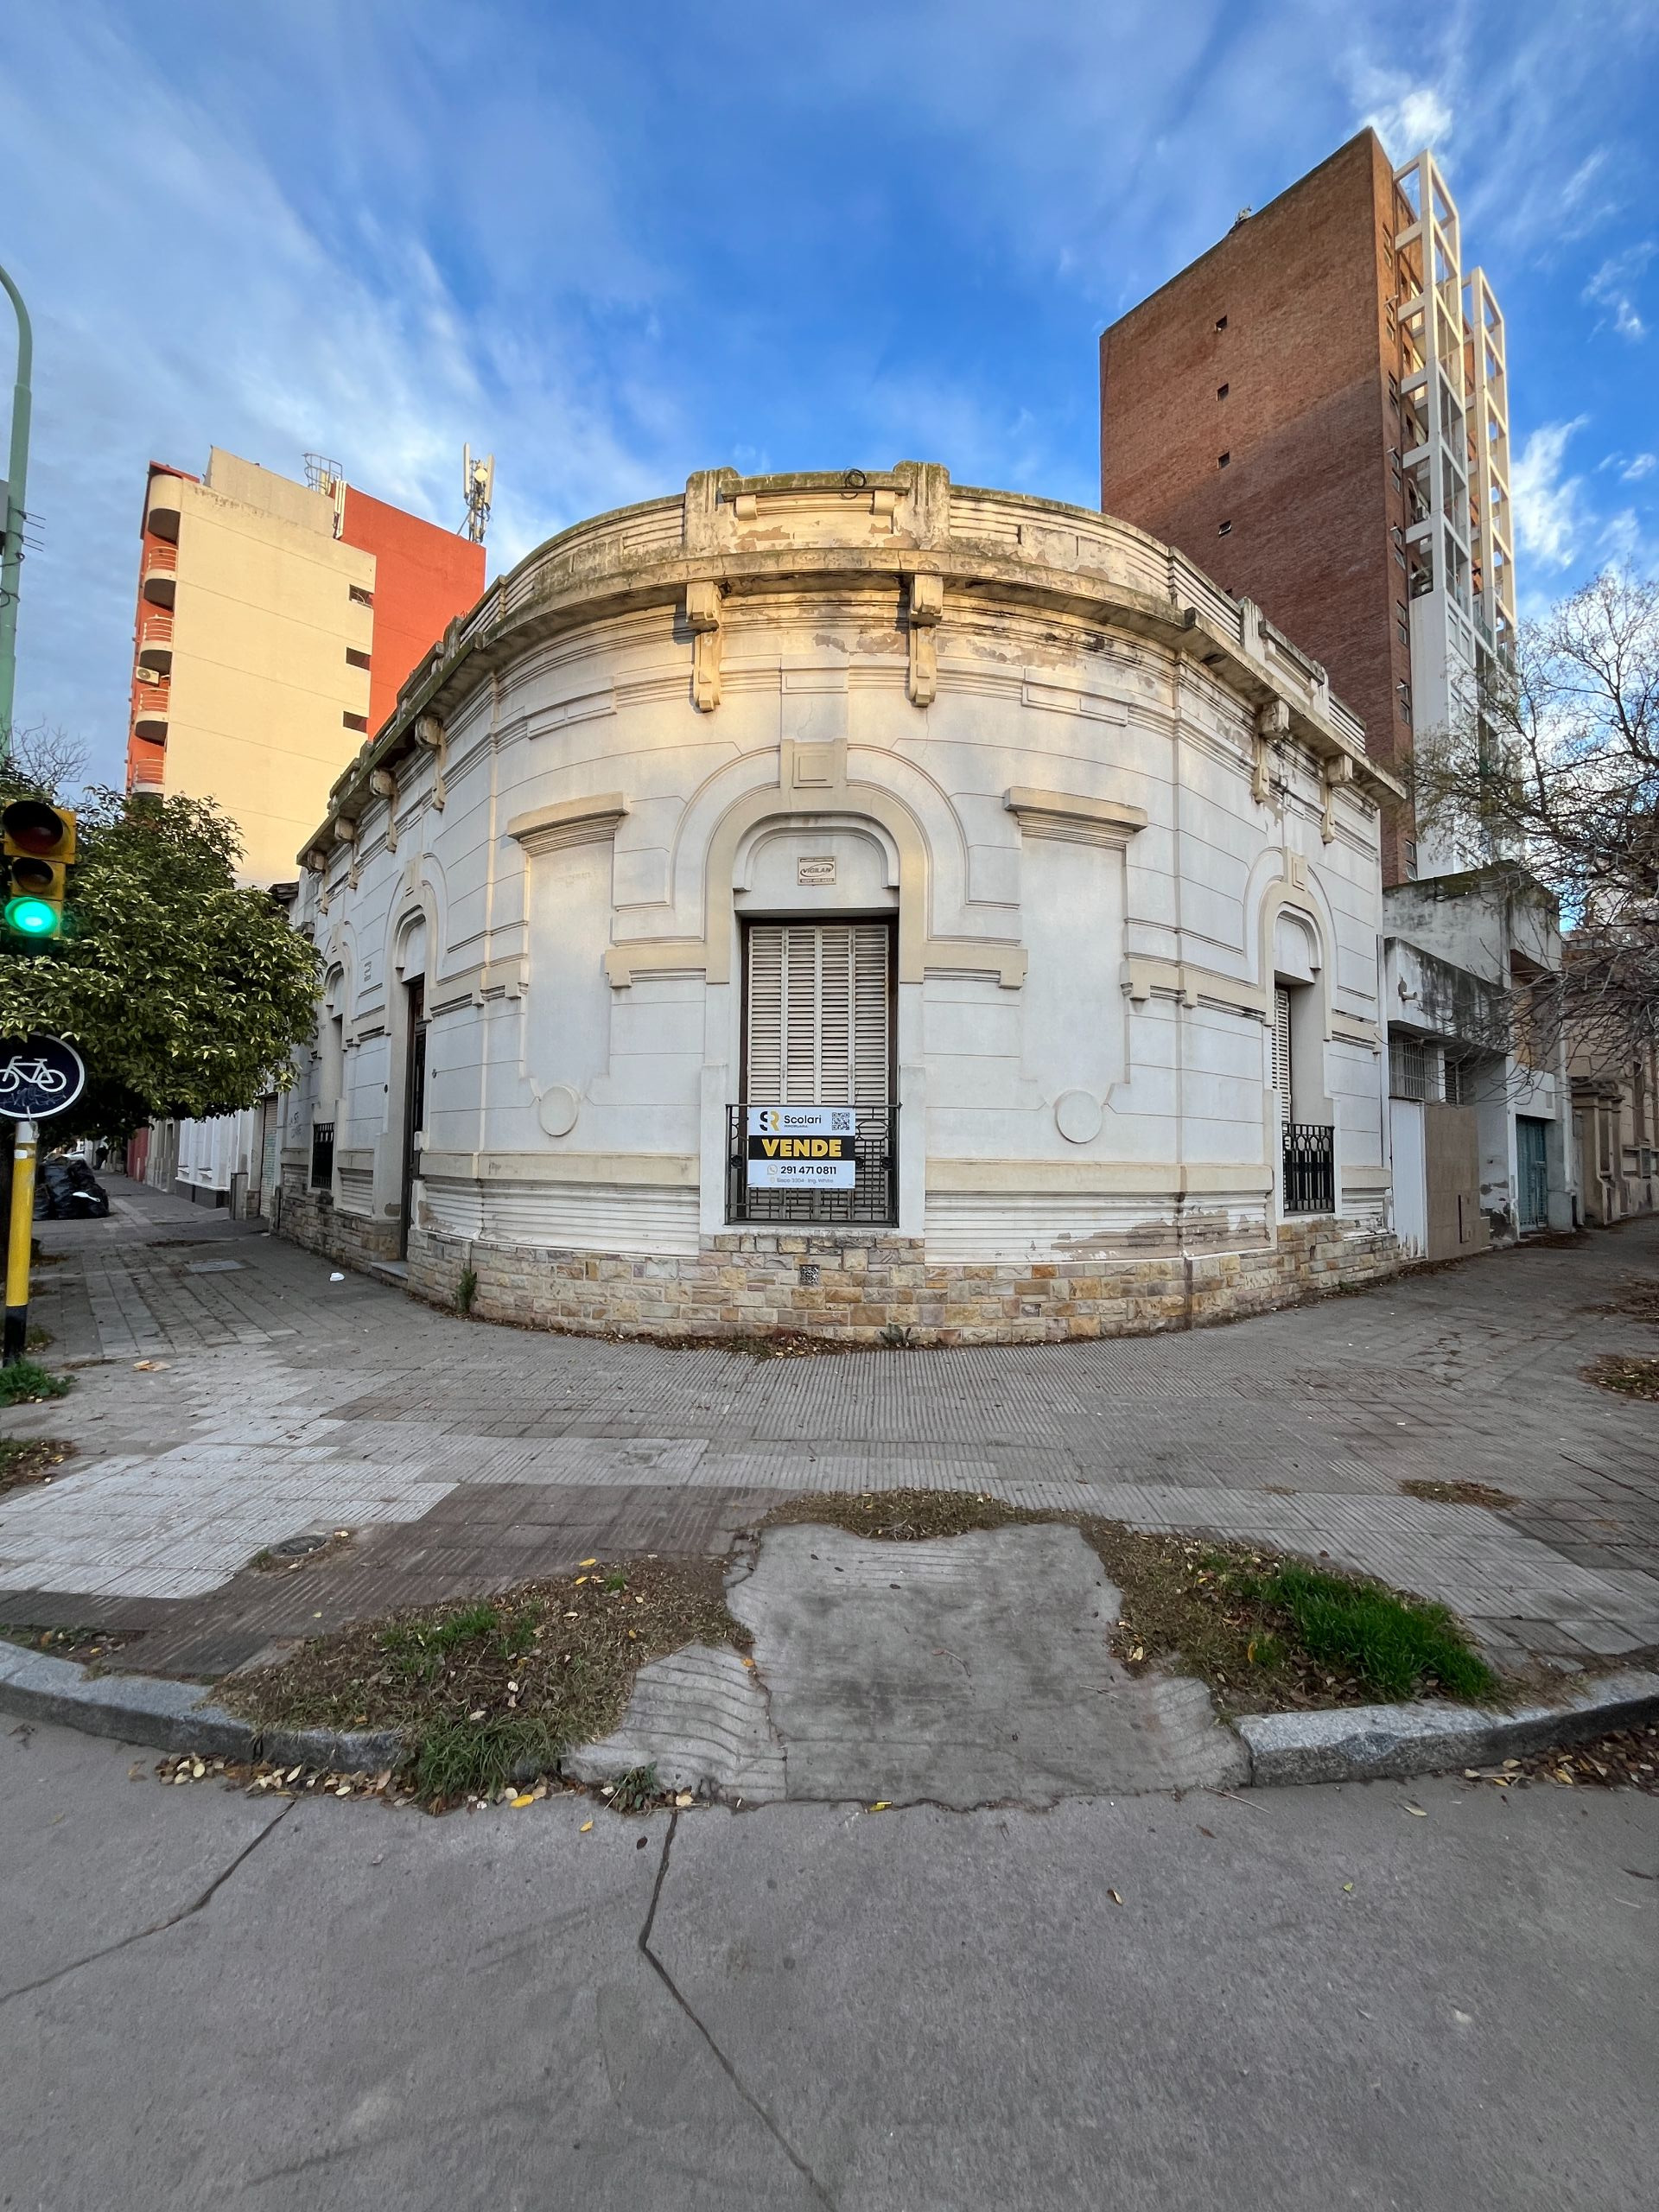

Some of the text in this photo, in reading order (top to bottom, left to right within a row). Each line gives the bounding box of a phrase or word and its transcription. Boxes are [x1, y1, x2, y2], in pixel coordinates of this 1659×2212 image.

[784, 1115, 822, 1124] Scolari
[761, 1139, 842, 1157] VENDE
[816, 1166, 836, 1175] 0811
